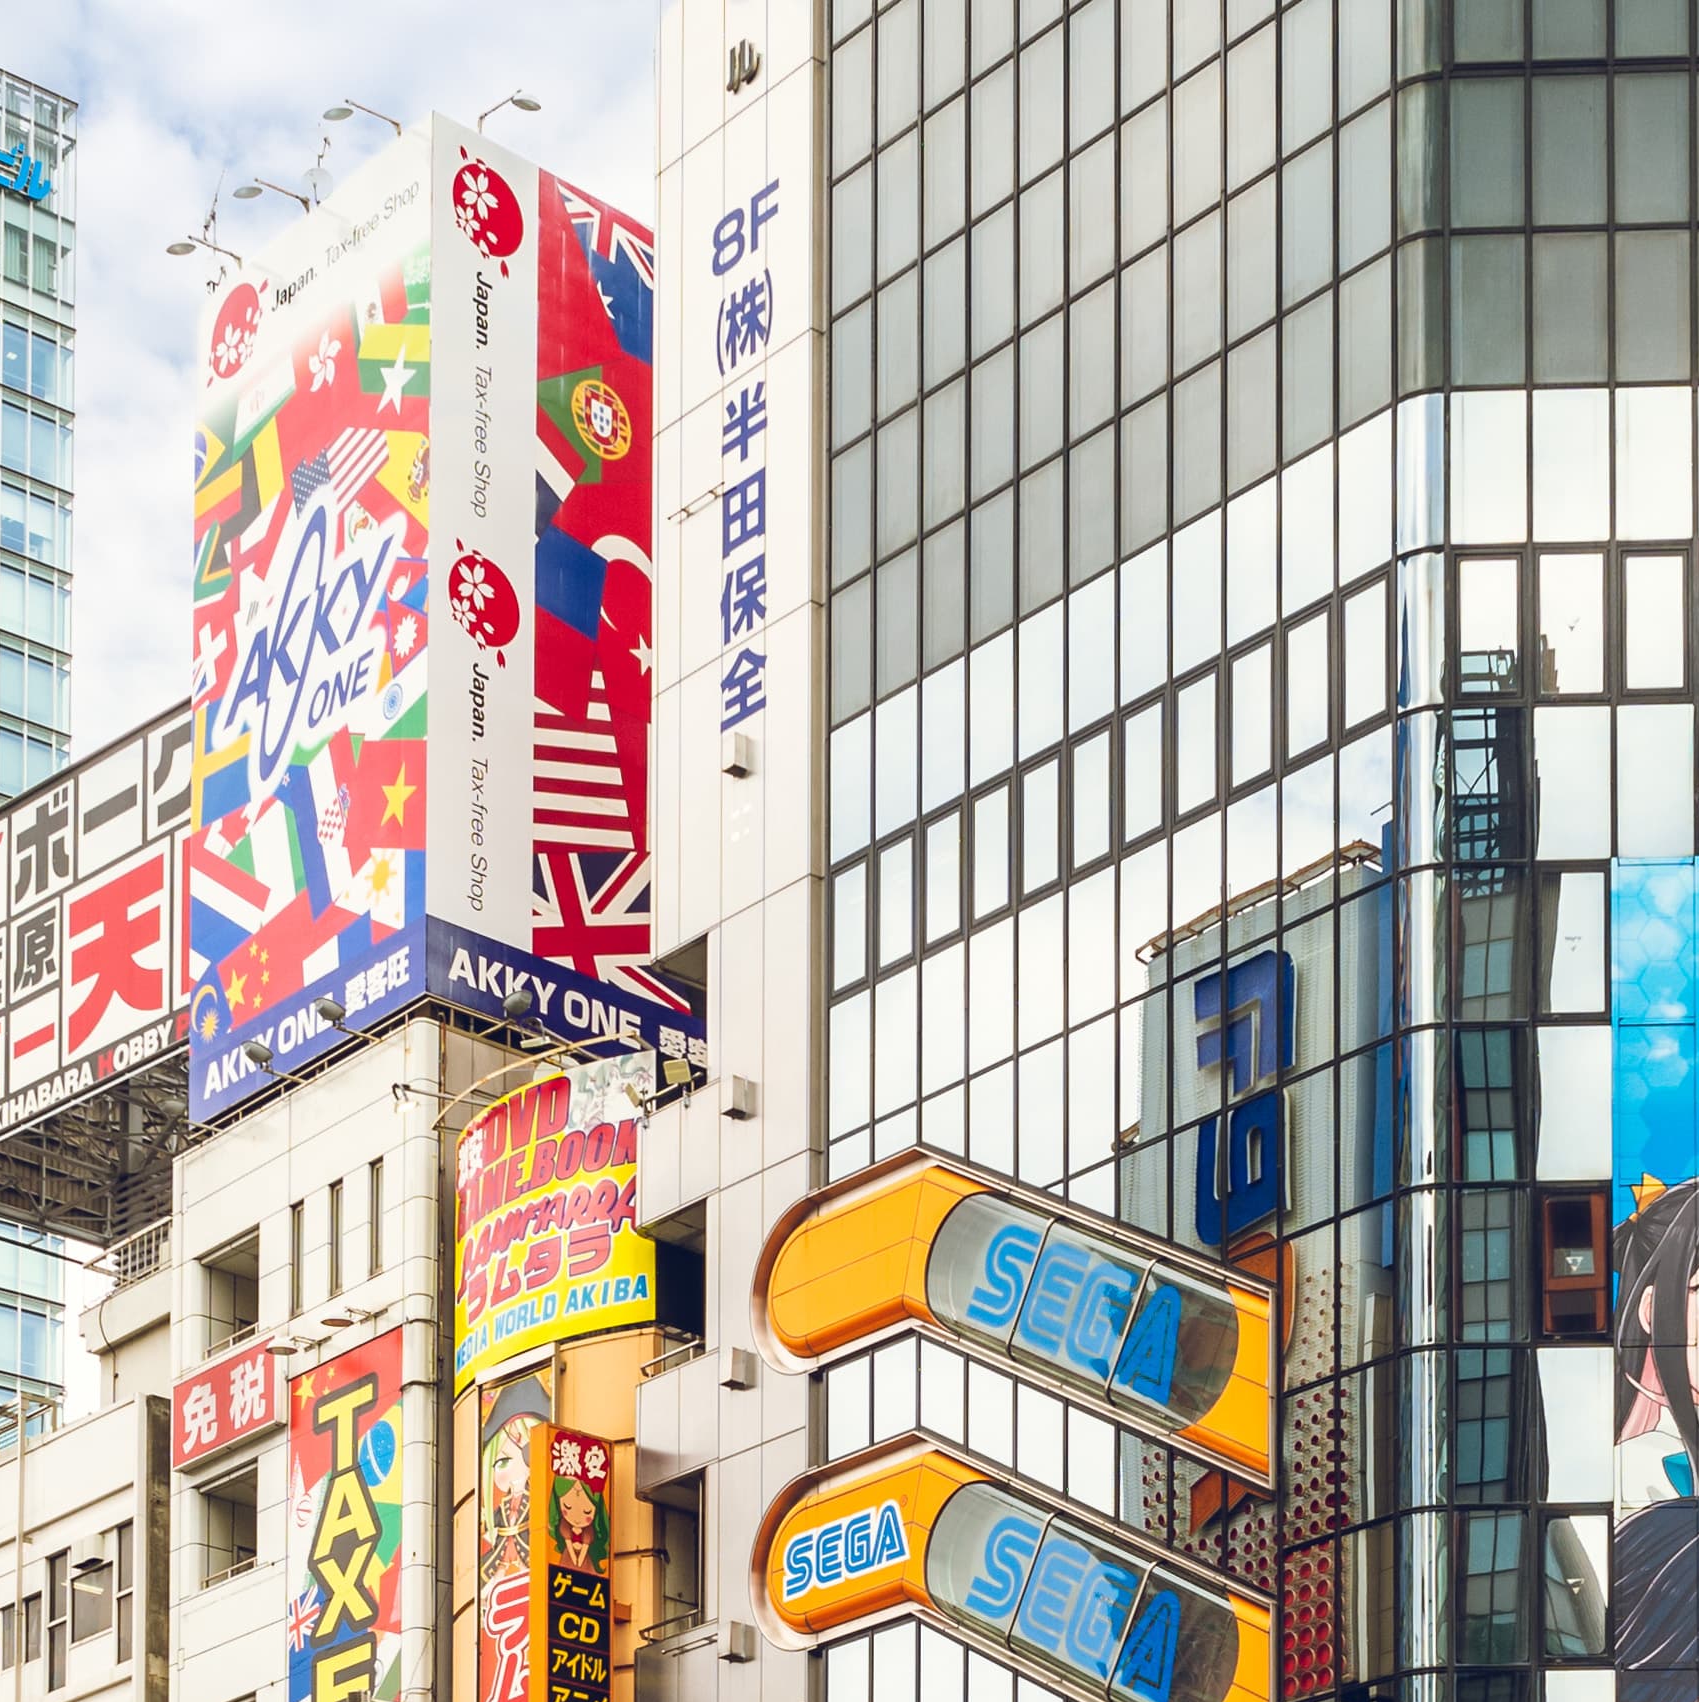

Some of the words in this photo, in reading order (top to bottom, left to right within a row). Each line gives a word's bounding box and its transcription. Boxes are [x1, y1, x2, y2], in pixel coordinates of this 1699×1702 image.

[272, 264, 318, 311] Japan.
[383, 180, 422, 227] Shop
[472, 270, 489, 351] Japan.
[471, 458, 489, 519] Shop
[308, 648, 374, 729] ONE
[471, 663, 489, 741] Japan.
[470, 852, 488, 912] Shop
[97, 1025, 172, 1077] HOBBY
[564, 990, 642, 1047] ONE
[467, 1224, 610, 1324] ラムタラ
[495, 1294, 556, 1339] WORLD
[564, 1275, 648, 1315] AKIBA
[967, 1223, 1181, 1406] SEGA
[181, 1357, 267, 1455] 免税
[315, 1382, 381, 1642] TAX
[554, 1572, 605, 1609] ゲーム
[784, 1506, 904, 1597] SEGA
[553, 1649, 607, 1682] アイドル
[558, 1612, 600, 1644] CD
